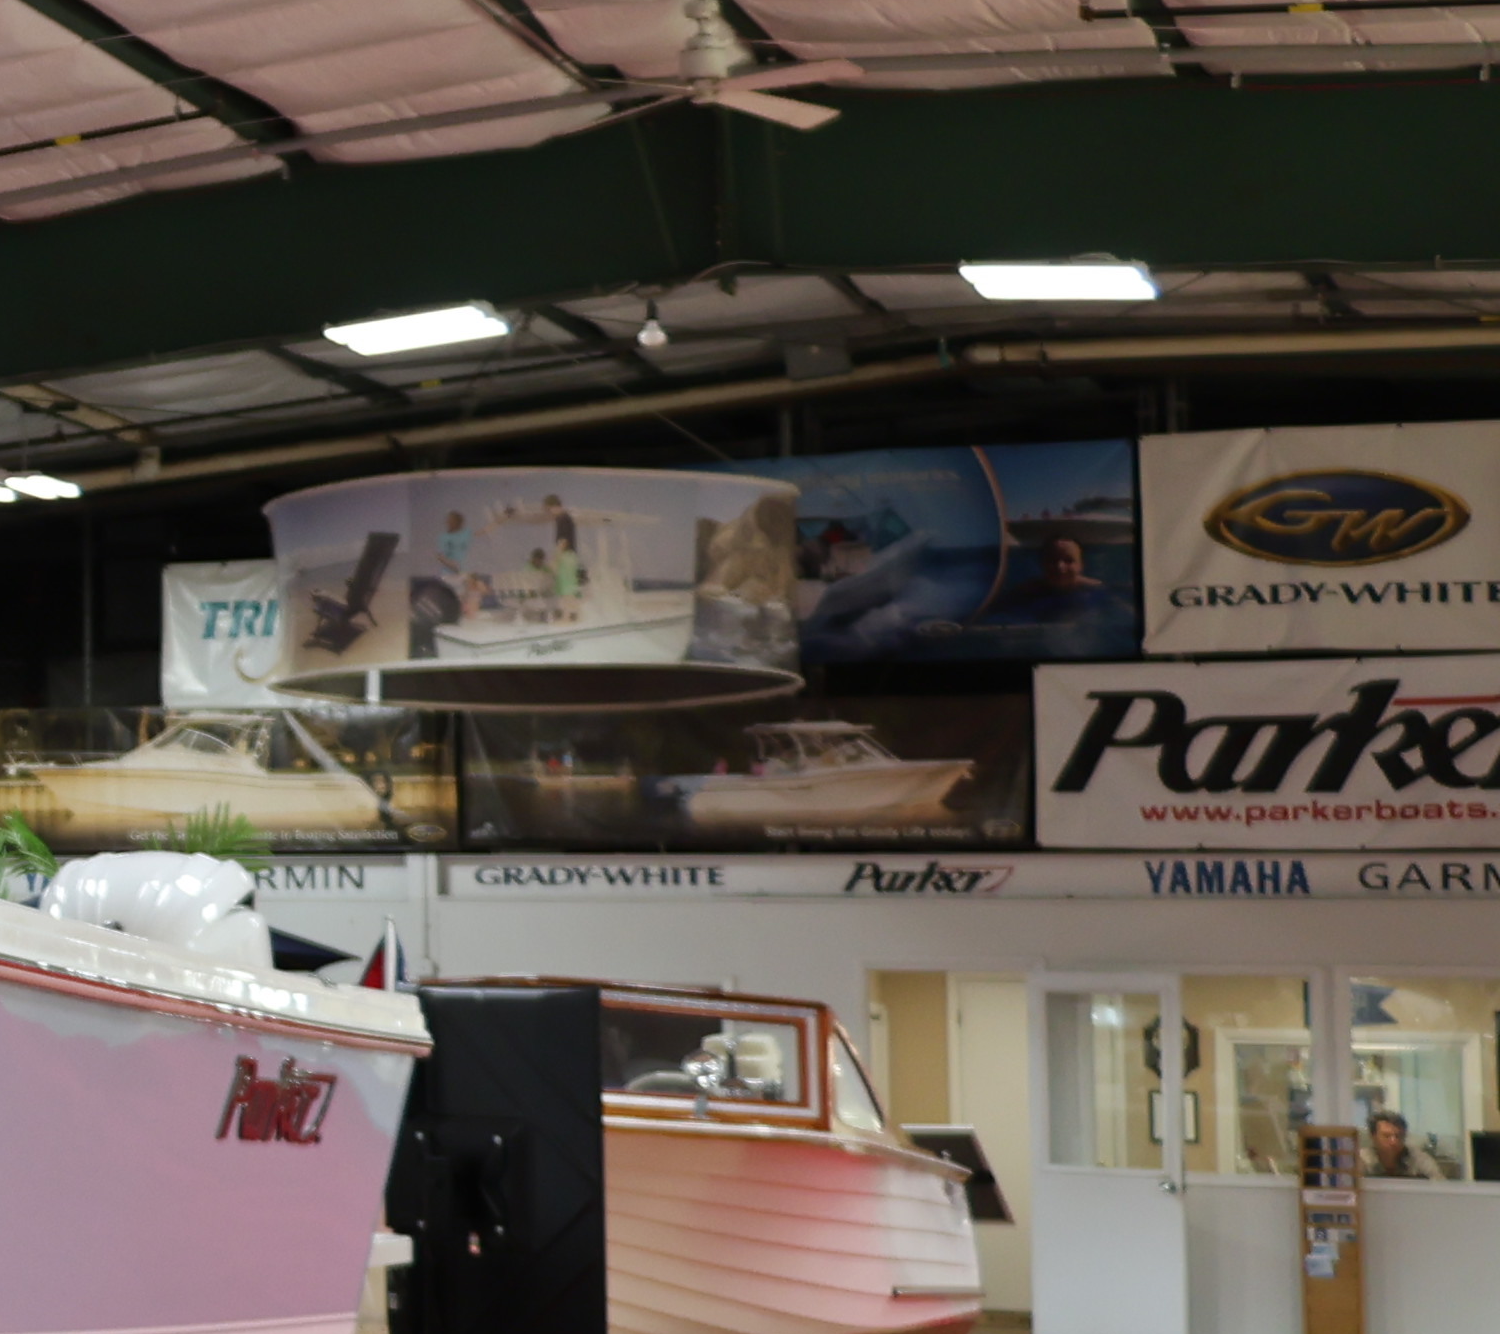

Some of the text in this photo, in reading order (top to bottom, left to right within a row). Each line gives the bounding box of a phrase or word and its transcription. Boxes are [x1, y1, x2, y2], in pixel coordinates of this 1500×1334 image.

[1050, 678, 1500, 794] Parke
[254, 866, 365, 890] RMIN
[473, 865, 726, 888] GRADY-WHITE
[843, 860, 992, 894] Parker
[1144, 860, 1311, 895] YAMAHA
